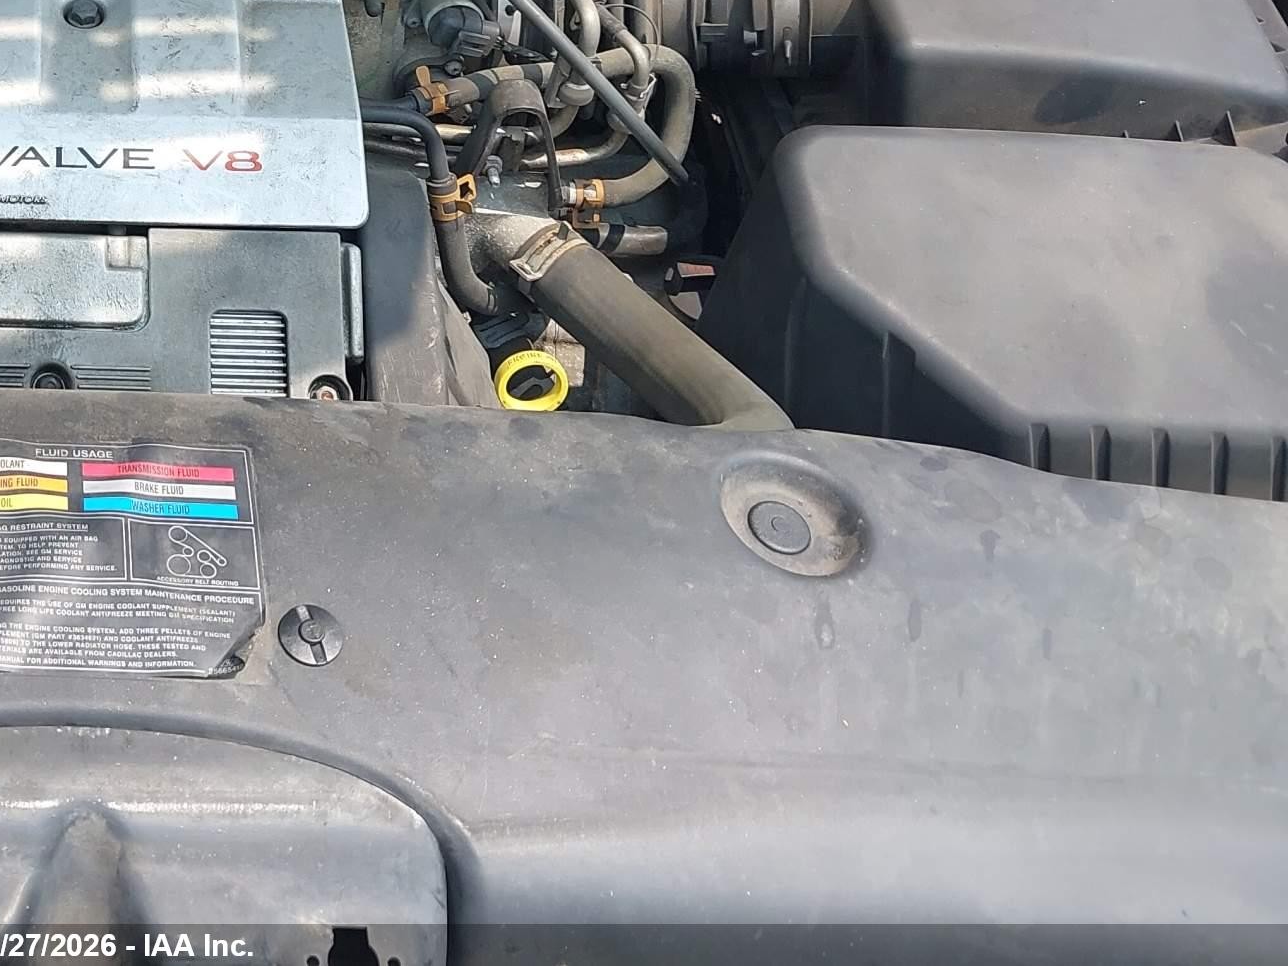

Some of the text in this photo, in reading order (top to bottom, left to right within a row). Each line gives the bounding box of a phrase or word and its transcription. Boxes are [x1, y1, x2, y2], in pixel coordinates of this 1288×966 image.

[182, 149, 263, 172] V8
[35, 448, 113, 459] FLUID USAGE
[117, 463, 201, 478] TRANSMISSION FLUID
[16, 477, 39, 487] FLUID
[134, 481, 184, 495] BRAKE FLUID
[0, 497, 14, 508] OIL
[130, 500, 191, 514] WASHER FLUID
[10, 523, 54, 531] RESTRAINT
[23, 562, 69, 570] PERFORMING
[156, 576, 193, 584] ACCESSORY
[38, 585, 69, 594] ENGINE
[71, 587, 108, 596] COOLING
[110, 588, 143, 596] SYSTEM
[144, 589, 202, 602] MAINTENANCE
[204, 595, 255, 605] PROCEDURE
[47, 600, 62, 608] USE
[88, 602, 115, 610] ENGINE
[151, 603, 198, 613] SUPPLEMENT
[181, 613, 234, 623] SPECIFICATION
[8, 622, 23, 630] THE
[160, 627, 191, 636] PELLETS
[204, 631, 231, 639] ENGINE
[44, 648, 83, 656] AVAILABLE
[107, 650, 142, 658] CADILLAC
[87, 659, 126, 667] WARNINGS
